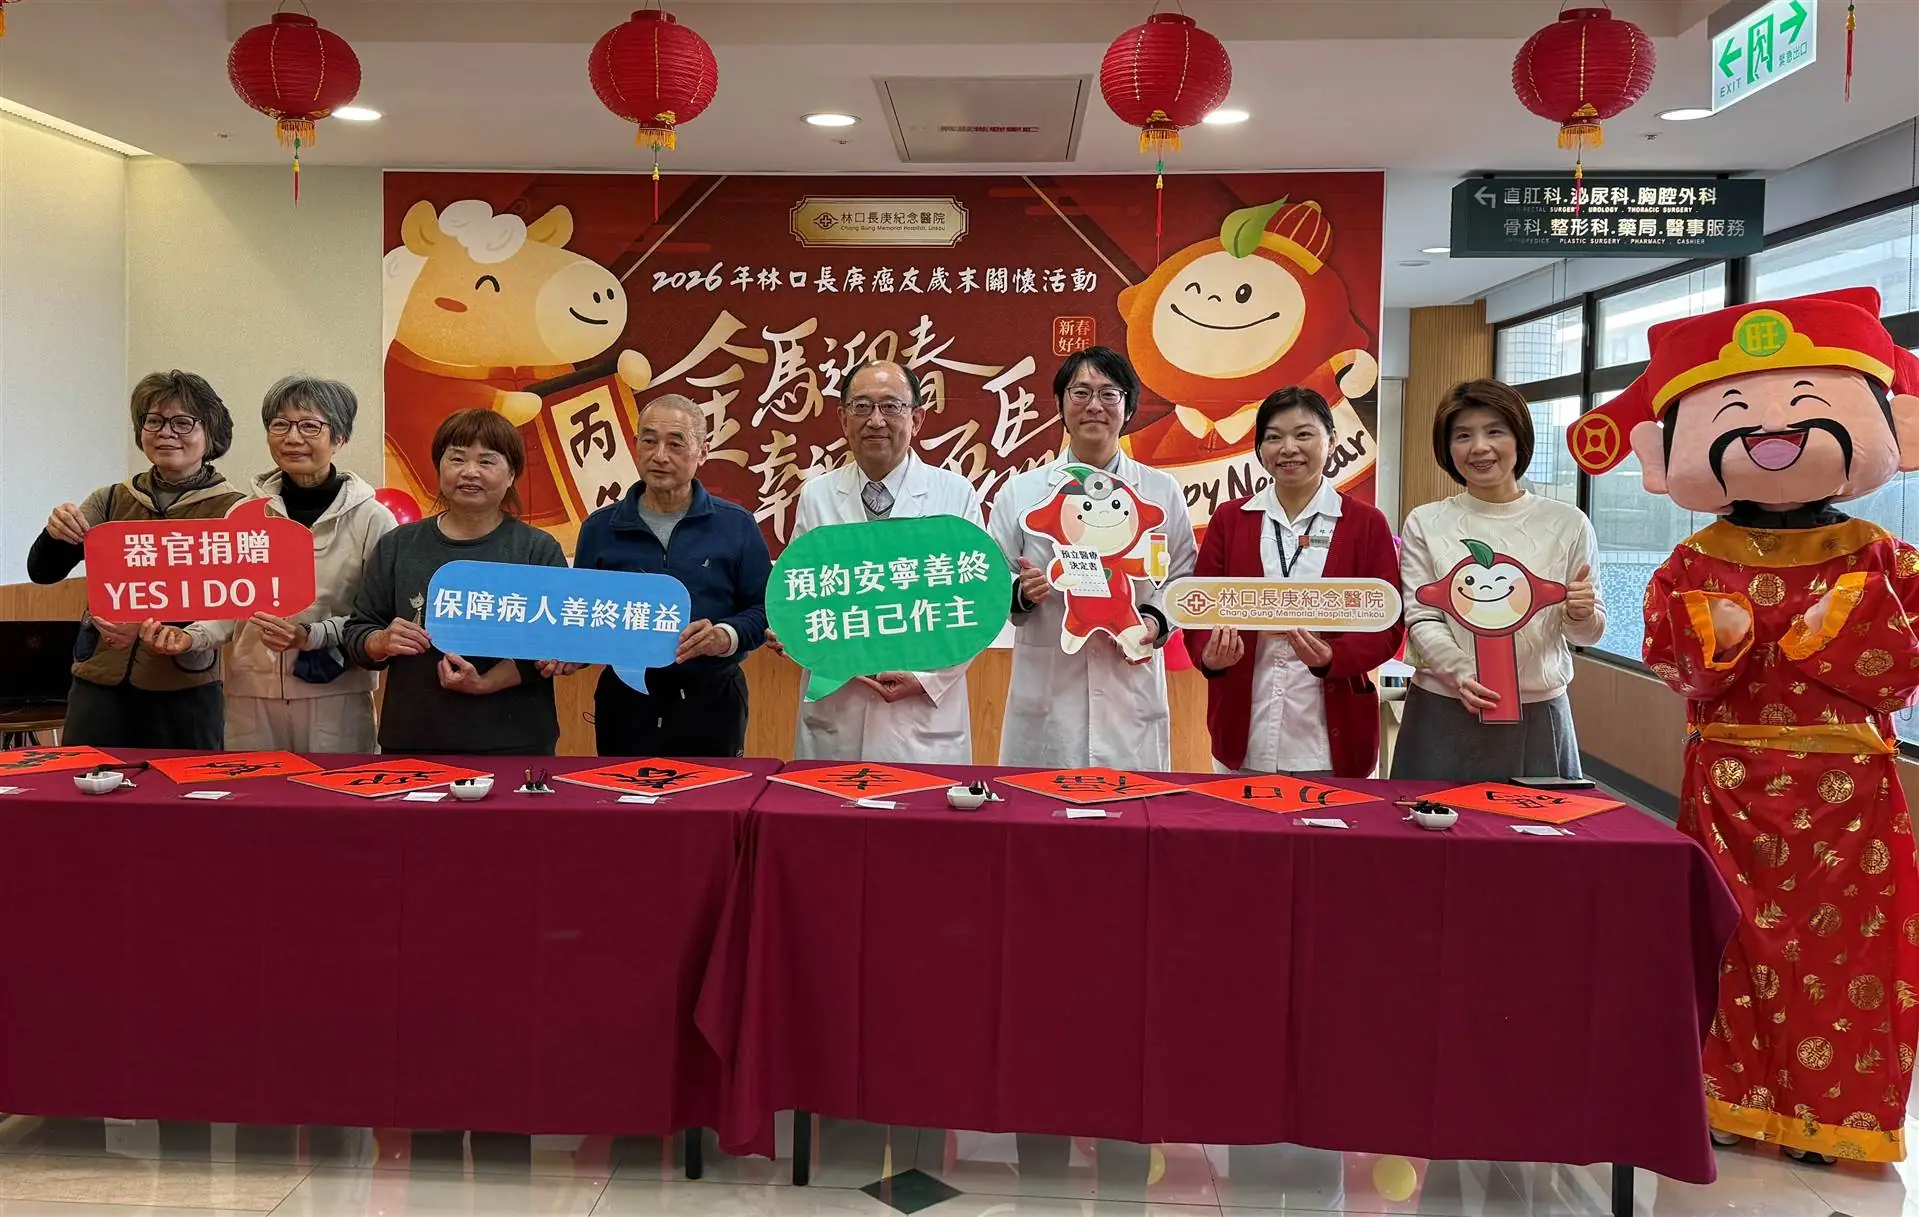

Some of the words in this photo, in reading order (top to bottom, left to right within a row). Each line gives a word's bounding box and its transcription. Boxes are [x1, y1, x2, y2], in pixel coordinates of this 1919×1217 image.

[1778, 41, 1808, 68] 緊急出口
[1720, 77, 1742, 98] EXIT
[841, 212, 945, 224] 林口長庚紀念醫院
[1746, 321, 1780, 352] 旺
[1228, 462, 1274, 500] Ne
[1322, 430, 1366, 478] ear
[123, 530, 270, 567] 器官捐贈
[1061, 550, 1098, 560] 預立醫療
[784, 550, 990, 601] 預約安寧善終
[1069, 561, 1097, 570] 決定書
[104, 580, 169, 610] YES
[181, 580, 189, 608] I
[1219, 589, 1384, 608] 林口長庚紀念醫院
[433, 587, 682, 633] 保障病人善終權益
[805, 595, 978, 642] 我自己作主
[1219, 609, 1247, 617] Chang
[1250, 609, 1273, 617] Gung
[1275, 609, 1314, 617] Memorial
[1317, 609, 1354, 618] Hospital,
[1357, 609, 1384, 617] Linkou
[596, 767, 688, 789] 春
[818, 768, 902, 790] 幸
[1052, 775, 1147, 796] 福
[1242, 785, 1334, 806] 加
